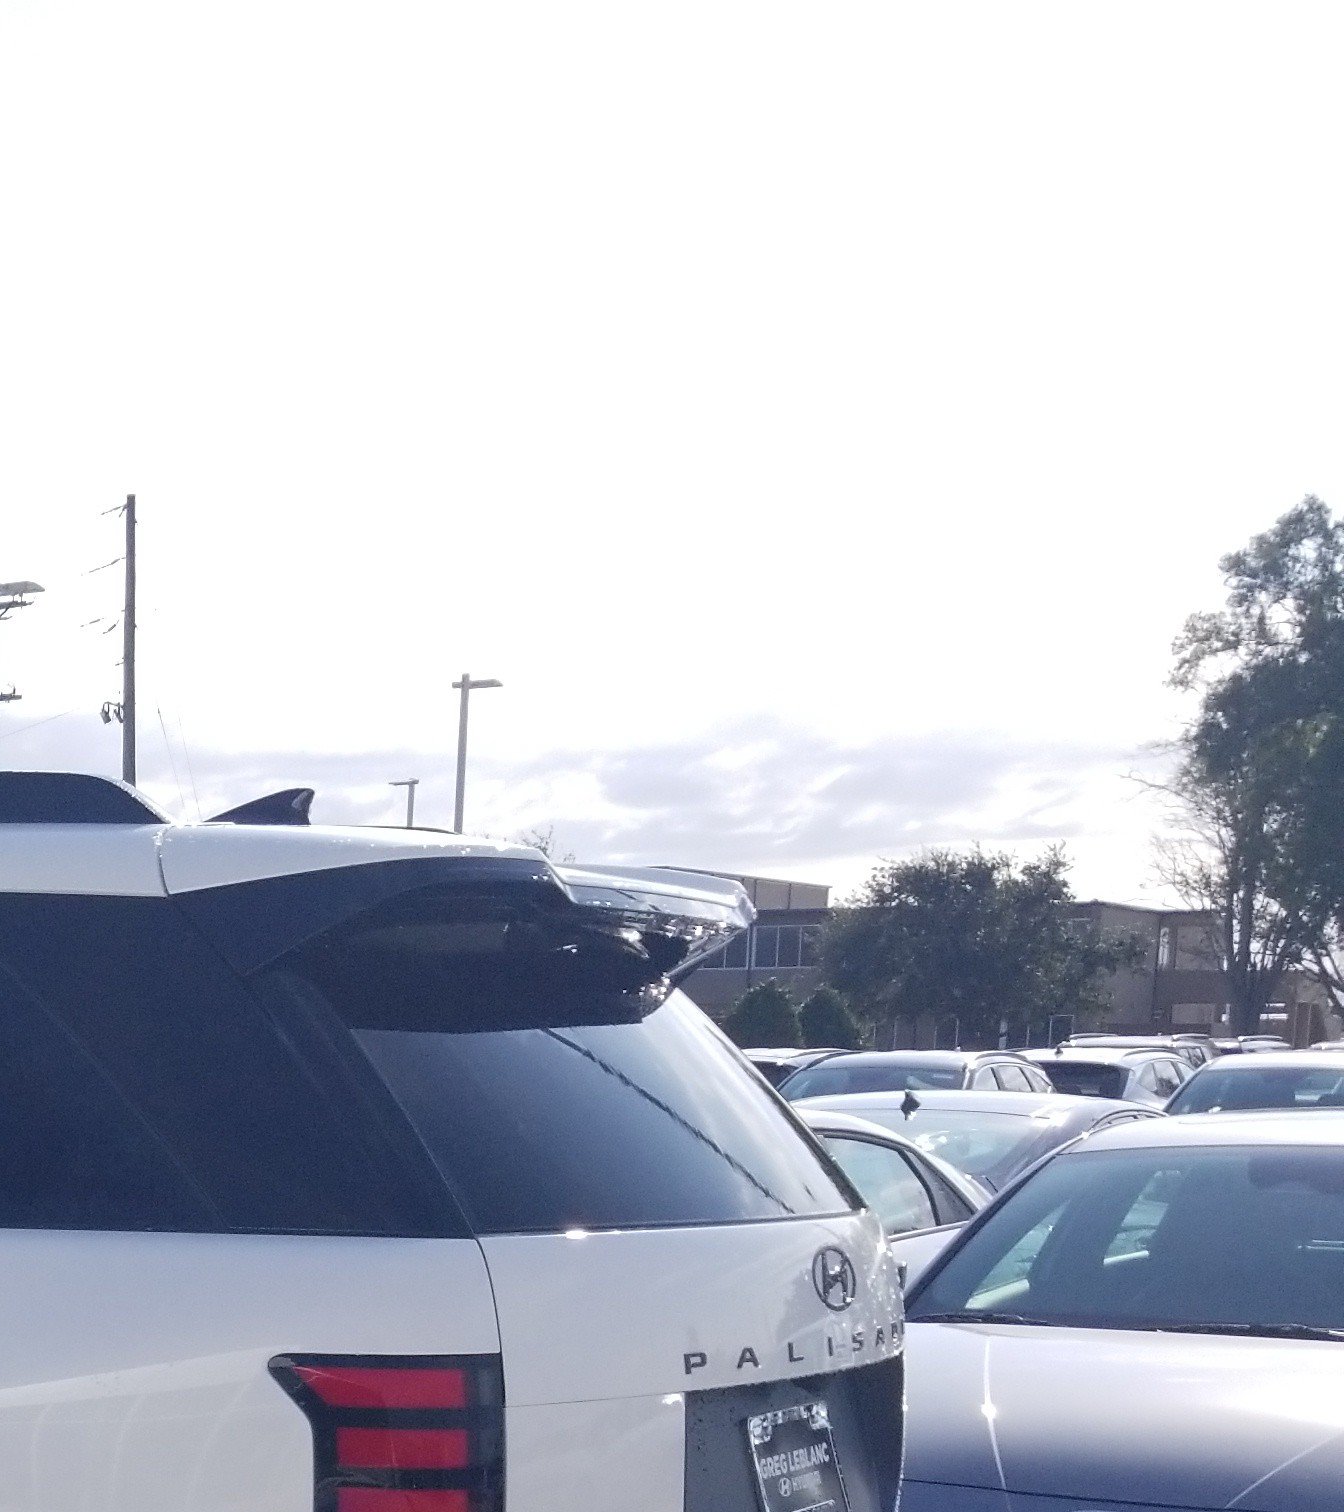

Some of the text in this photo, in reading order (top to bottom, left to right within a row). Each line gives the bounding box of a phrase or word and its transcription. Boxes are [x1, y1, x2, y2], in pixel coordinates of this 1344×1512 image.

[683, 1319, 905, 1375] PALISAD
[759, 1442, 830, 1479] GREG LEBLANC
